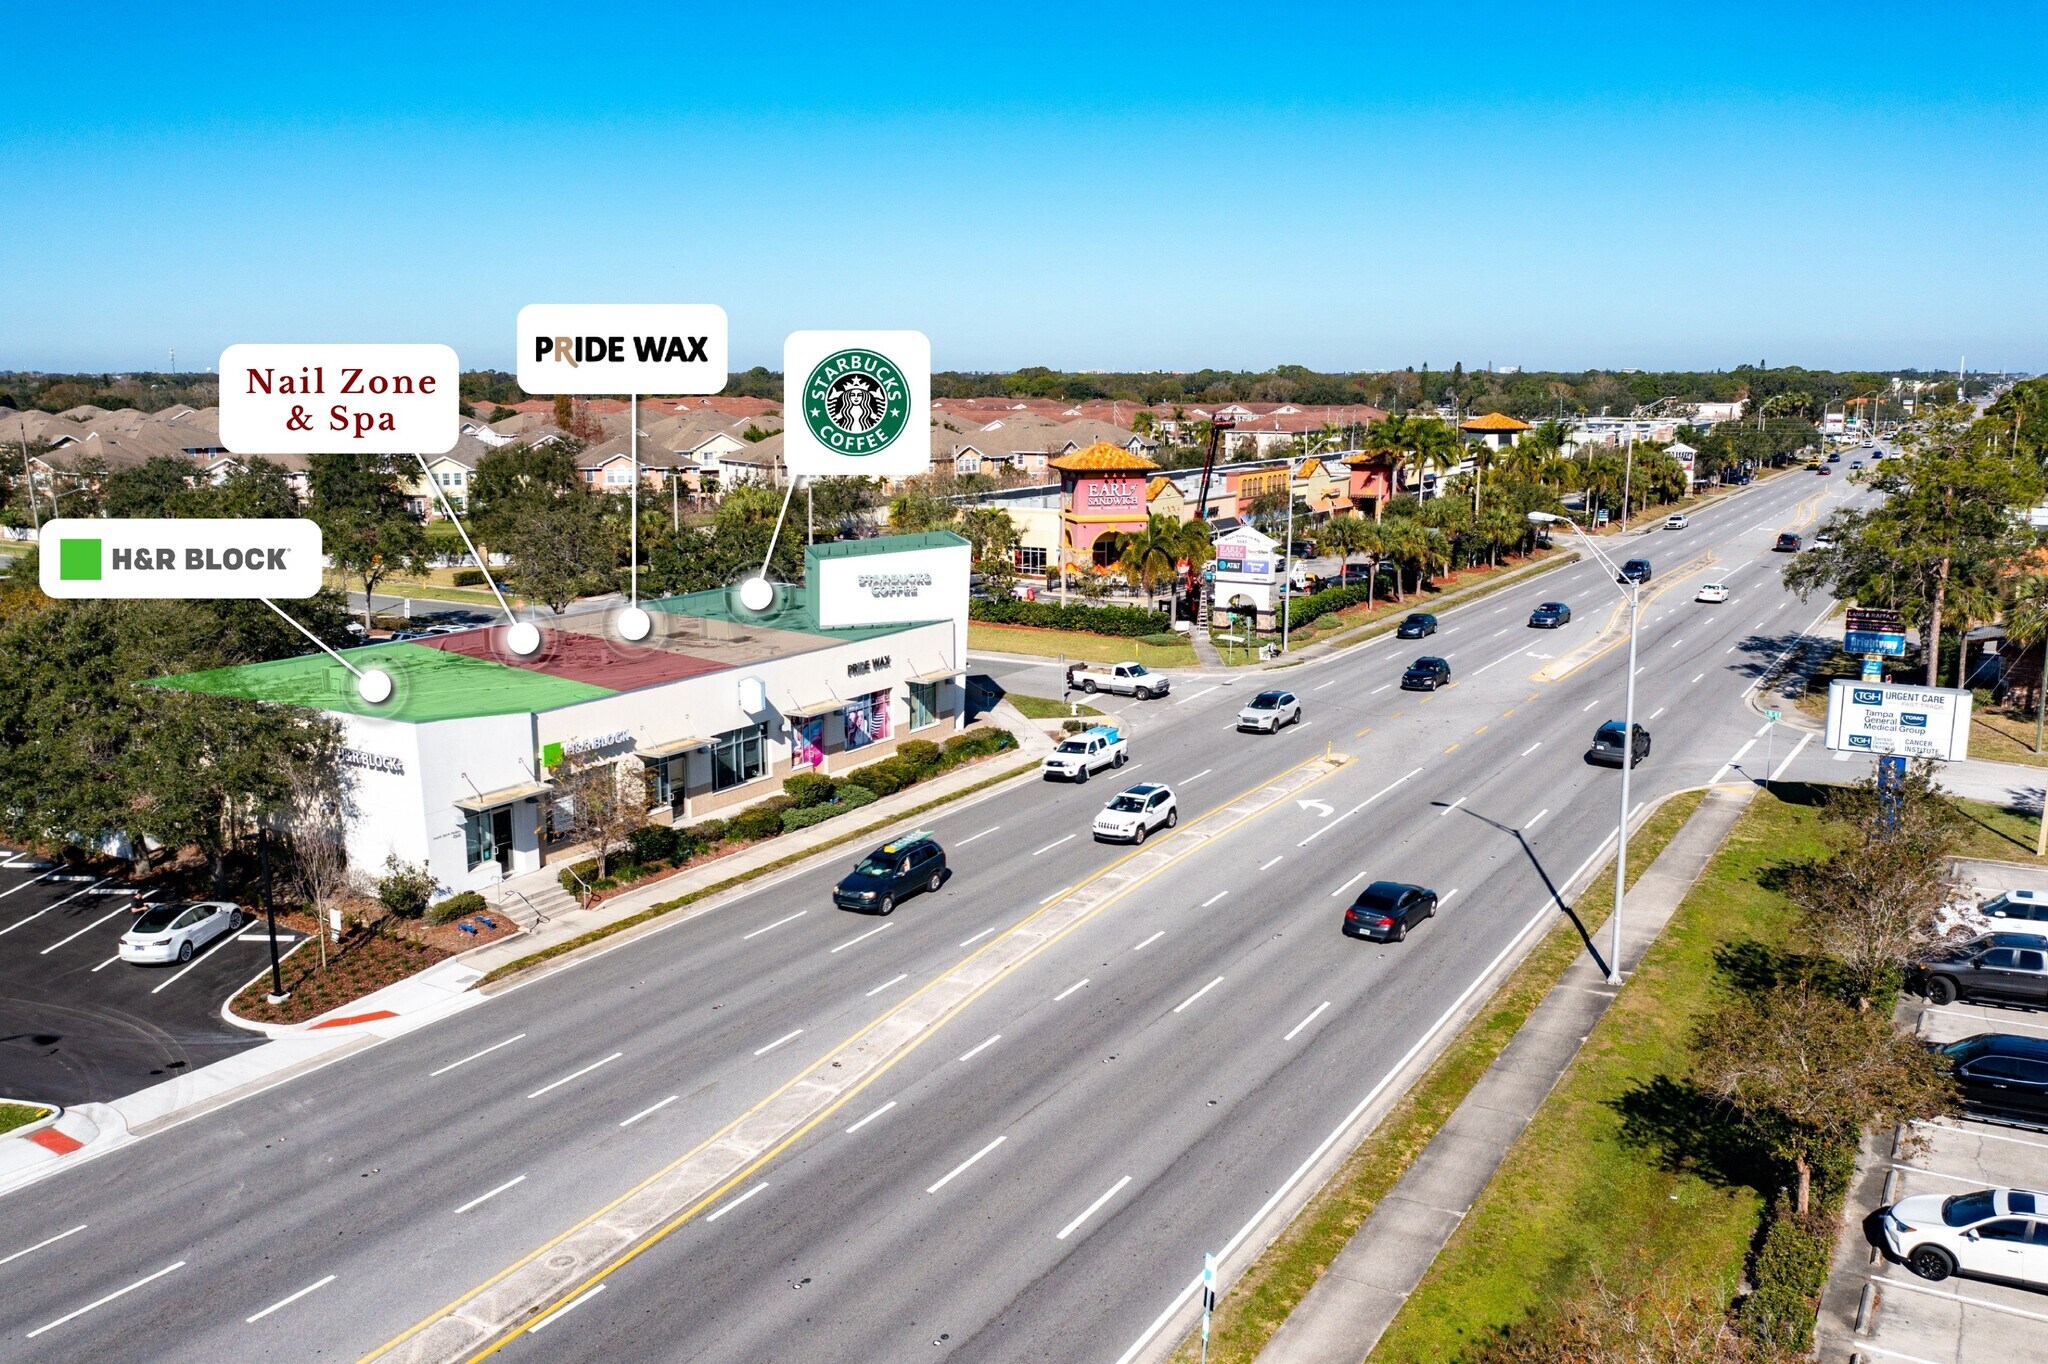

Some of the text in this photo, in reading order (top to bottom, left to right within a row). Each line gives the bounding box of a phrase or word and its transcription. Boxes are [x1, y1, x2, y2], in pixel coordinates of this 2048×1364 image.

[1088, 483, 1131, 497] EARL
[1088, 496, 1138, 506] SANDWICH
[1226, 561, 1241, 569] AT&T
[1856, 691, 1945, 704] TGH URGENT CARE
[1865, 709, 1894, 718] Tampa
[1864, 715, 1898, 725] General
[1863, 723, 1926, 736] Medical Group
[592, 729, 631, 749] BLOCK
[1904, 738, 1933, 747] CANCER
[361, 751, 398, 771] BLOCK
